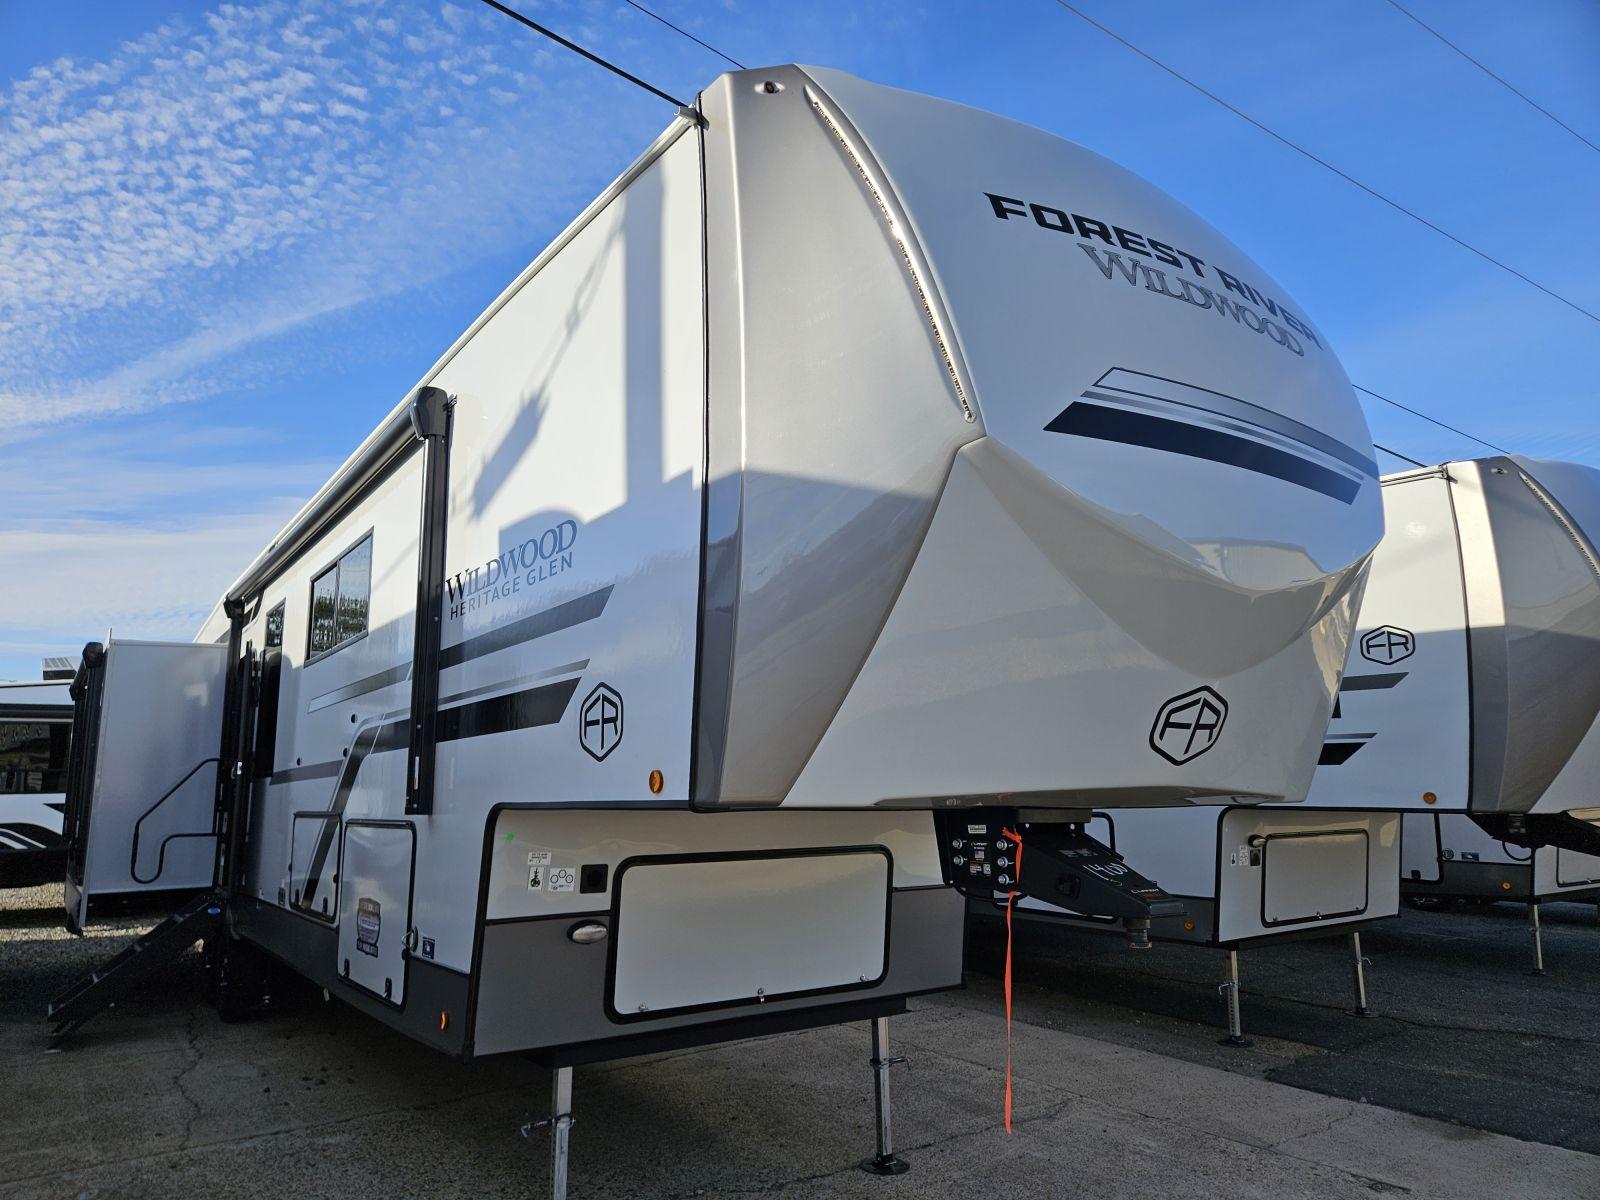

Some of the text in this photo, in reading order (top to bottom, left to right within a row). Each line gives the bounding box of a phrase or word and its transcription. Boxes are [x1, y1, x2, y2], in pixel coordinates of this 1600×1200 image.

[983, 191, 1324, 349] FOREST RIVER
[1077, 243, 1305, 357] WILDWOOD
[445, 519, 578, 604] WILDWOOD
[449, 551, 573, 621] HERITAGE GLEN
